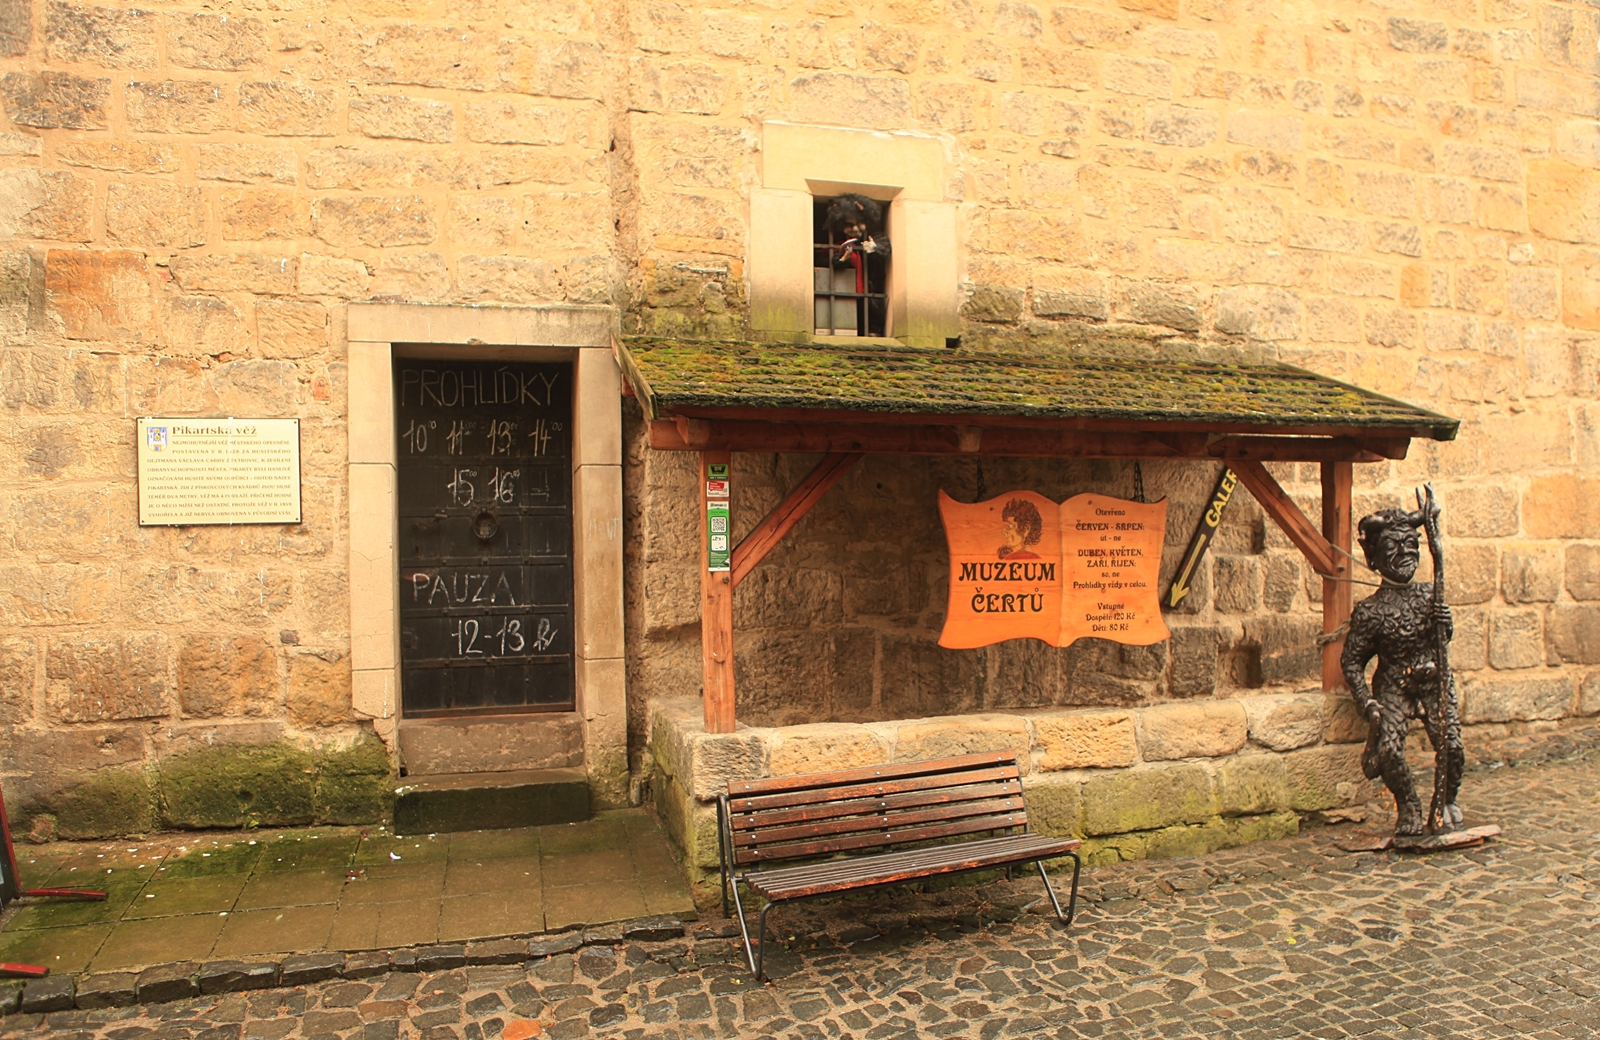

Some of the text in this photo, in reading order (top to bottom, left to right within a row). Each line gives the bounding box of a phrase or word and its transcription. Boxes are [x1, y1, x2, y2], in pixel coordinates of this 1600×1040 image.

[401, 366, 560, 407] PROHLÍDKY
[172, 426, 257, 435] Pikartská věž
[1095, 508, 1126, 516] Otevřeno
[1076, 519, 1109, 531] ČERVEN
[1115, 522, 1144, 531] SRPEN:
[1078, 545, 1144, 557] DUBEN, KVĚTEN,
[958, 562, 1056, 582] MUZEUM
[412, 571, 516, 606] PAUZA
[1108, 580, 1122, 589] vždy
[971, 586, 1044, 613] ČERTŮ
